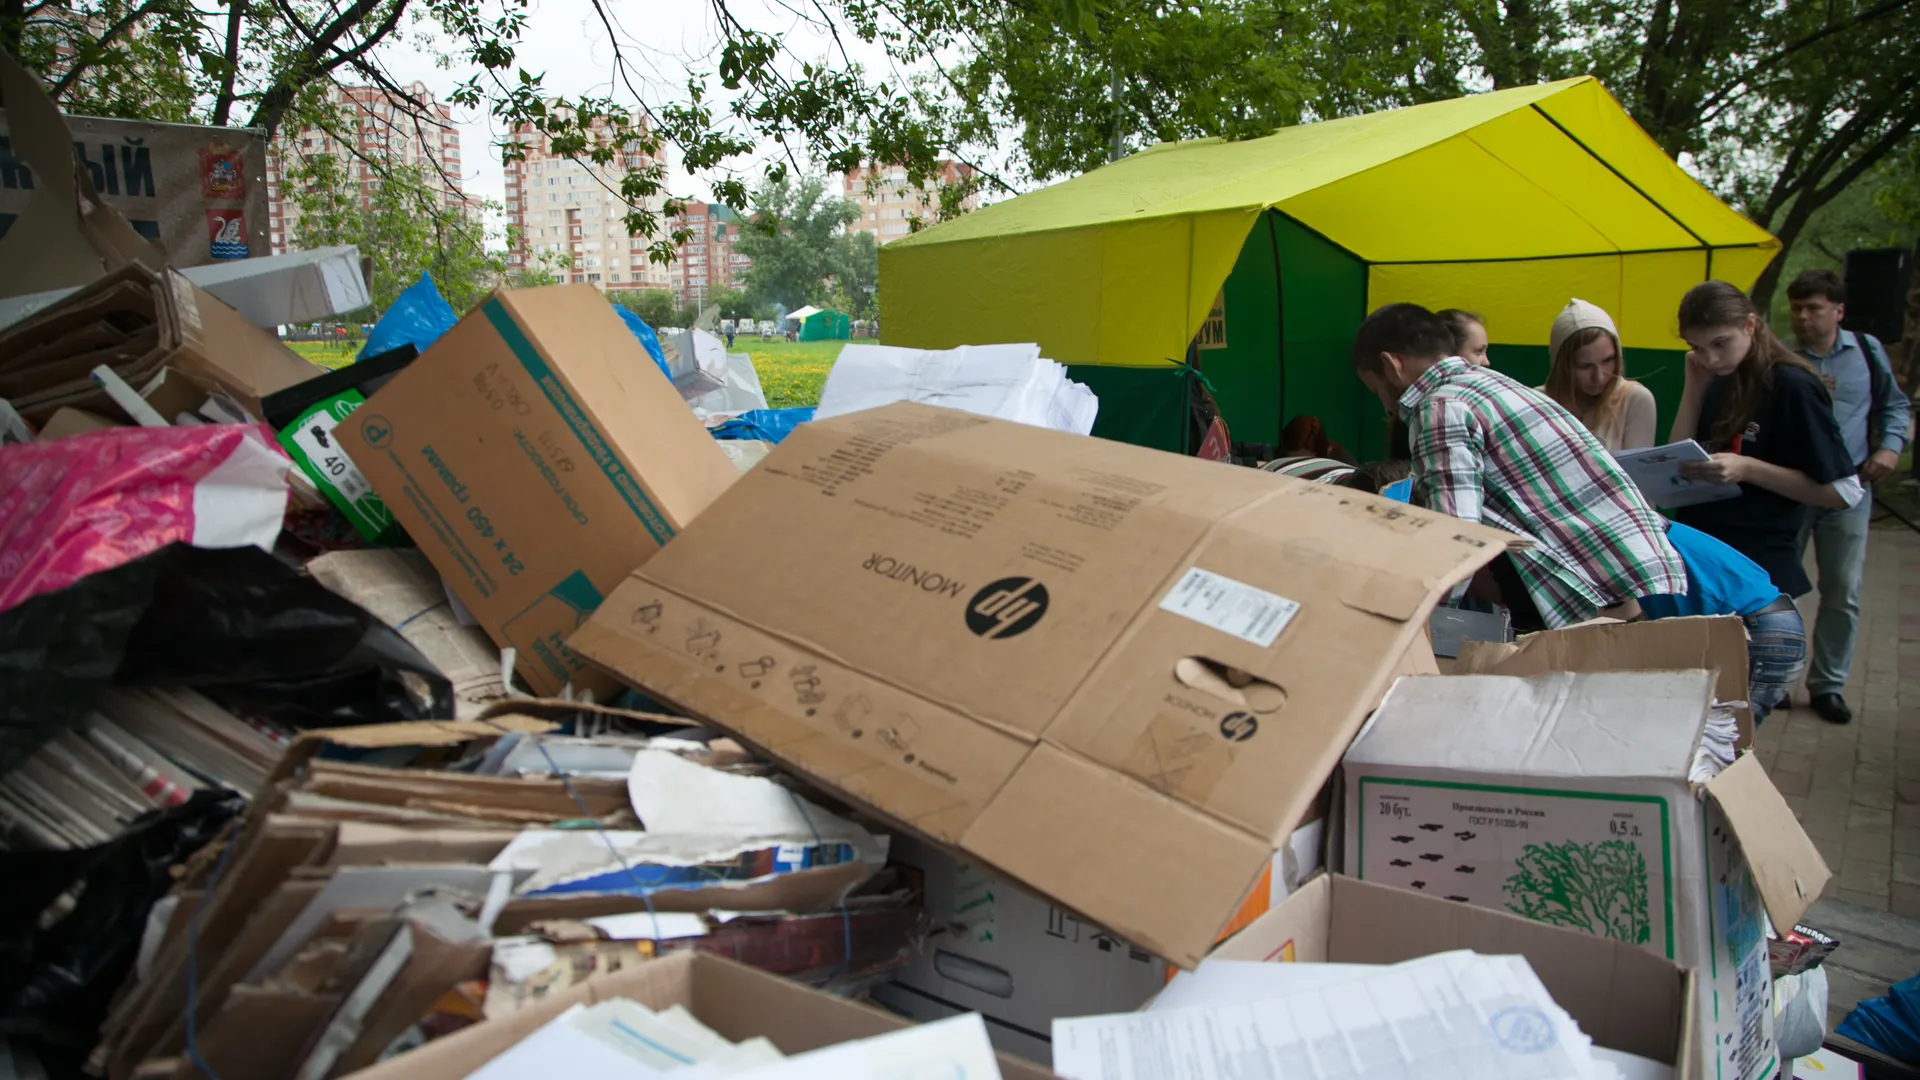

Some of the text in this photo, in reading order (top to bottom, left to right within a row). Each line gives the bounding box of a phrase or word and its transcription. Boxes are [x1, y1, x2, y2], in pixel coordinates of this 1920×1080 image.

[366, 425, 388, 443] P
[324, 456, 346, 476] 40
[421, 444, 471, 503] грамм
[466, 507, 495, 537] 450
[501, 551, 525, 576] 24
[862, 552, 967, 599] MONITOR
[970, 578, 1043, 639] hp
[1222, 713, 1256, 742] hp
[1379, 802, 1411, 820] 20 бут.
[1452, 802, 1506, 814] Произведено
[1514, 807, 1546, 817] России
[1468, 816, 1486, 826] ГОСТ
[1610, 820, 1643, 838] 0,5 л.
